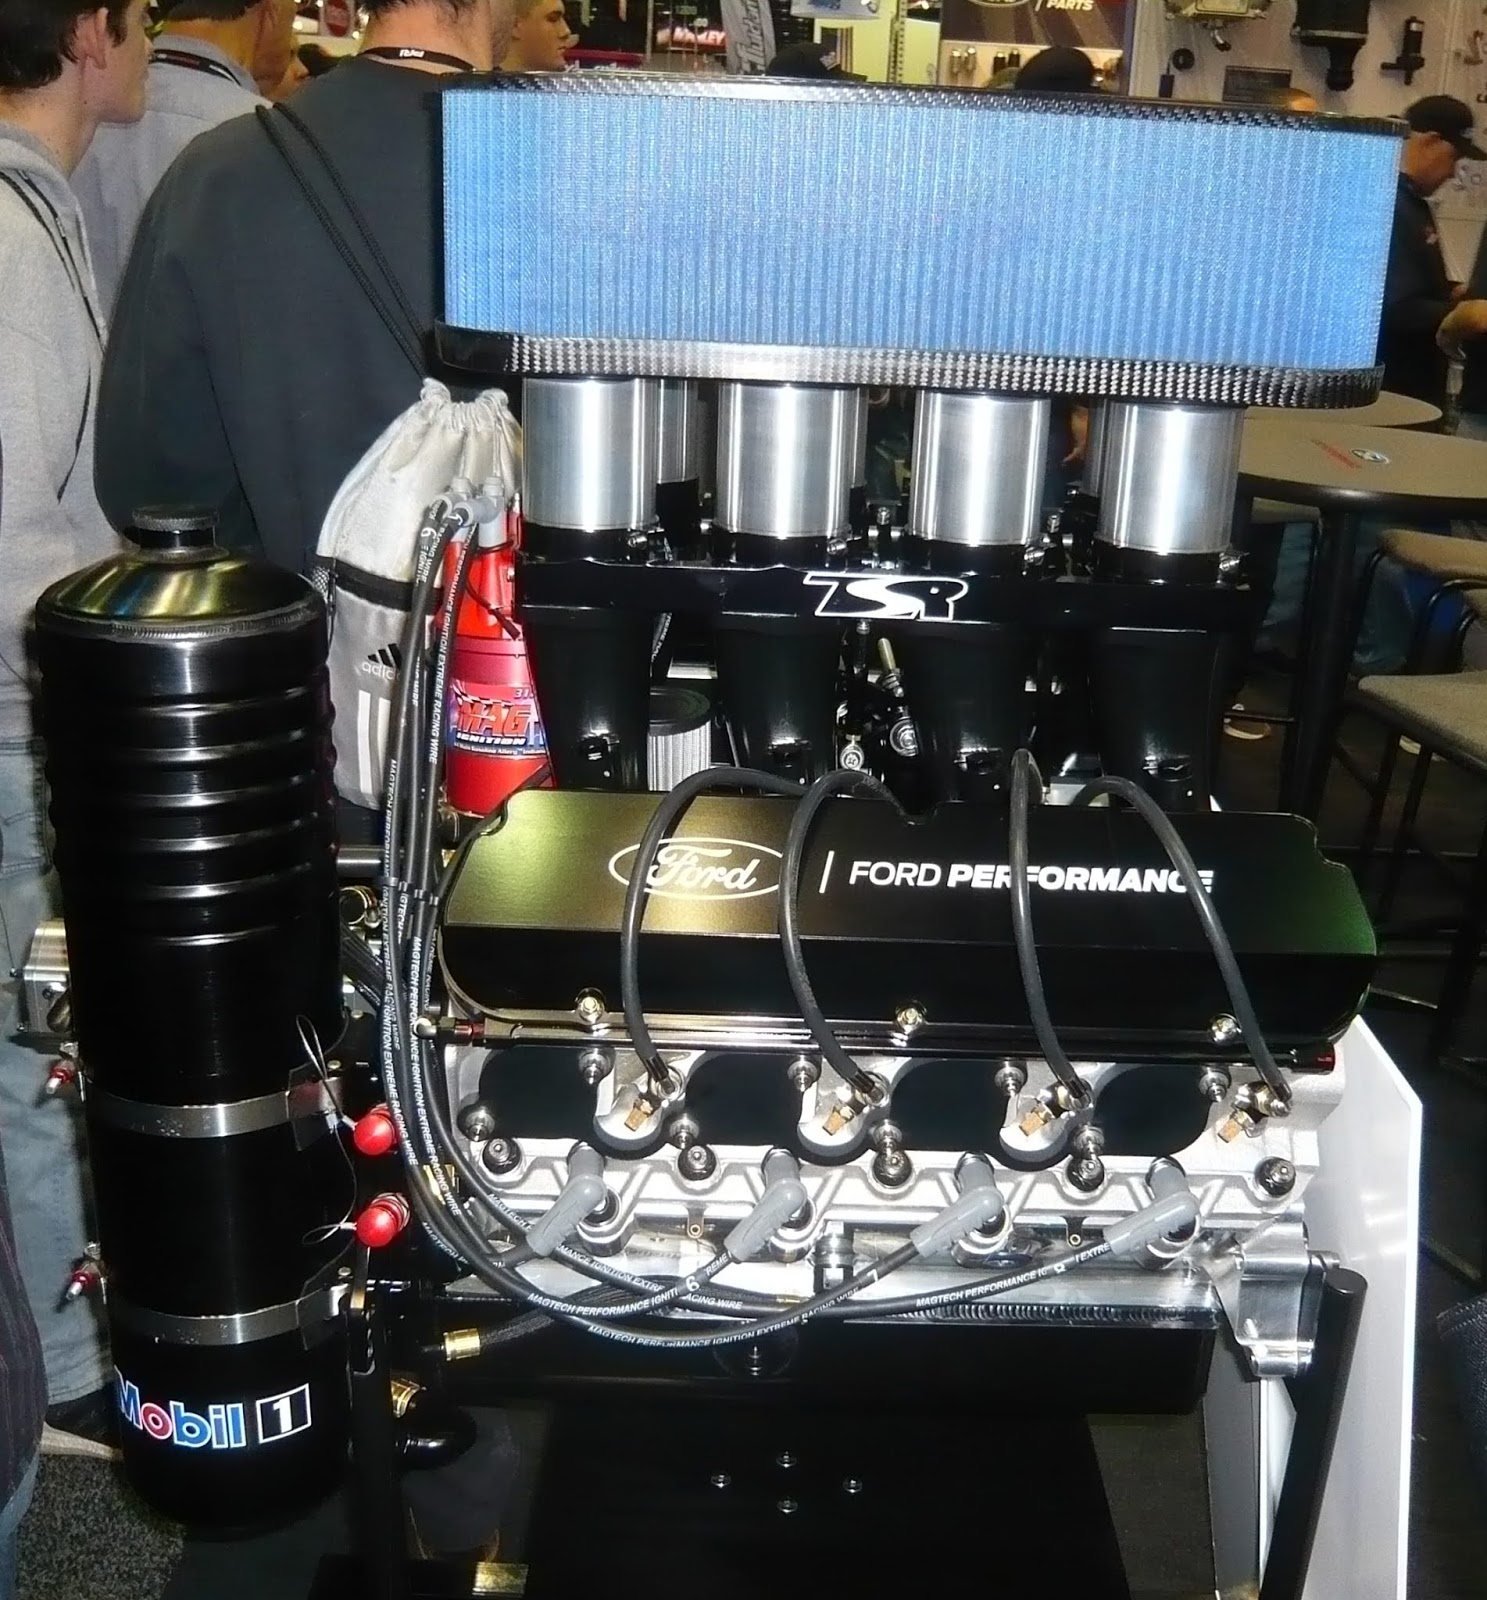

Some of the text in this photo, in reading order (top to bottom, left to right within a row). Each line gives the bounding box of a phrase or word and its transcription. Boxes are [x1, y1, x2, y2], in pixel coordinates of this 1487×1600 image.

[439, 612, 451, 655] IGNITION
[434, 653, 446, 700] EXTREME
[431, 699, 442, 739] RACING
[429, 738, 440, 765] WIRE
[647, 845, 761, 890] Ford
[849, 861, 1214, 893] FORD PERFORMANCE
[382, 1004, 393, 1050] IGNITION
[383, 1050, 399, 1099] EXTREME
[409, 936, 463, 1217] MAGTECH PERFORANCE IGNITION EXTREME RACING WIRE
[391, 1099, 409, 1138] RACING
[404, 1138, 420, 1166] WIRE
[685, 1275, 701, 1292] 6
[915, 1292, 964, 1308] MAGTECH
[964, 1270, 1037, 1299] PERFORMANCE
[527, 1292, 575, 1314] MAGTECH
[575, 1301, 650, 1317] PERFORMANCE
[716, 1298, 744, 1310] WIRE
[587, 1325, 635, 1345] MAGTECH
[114, 1364, 246, 1449] Mobil
